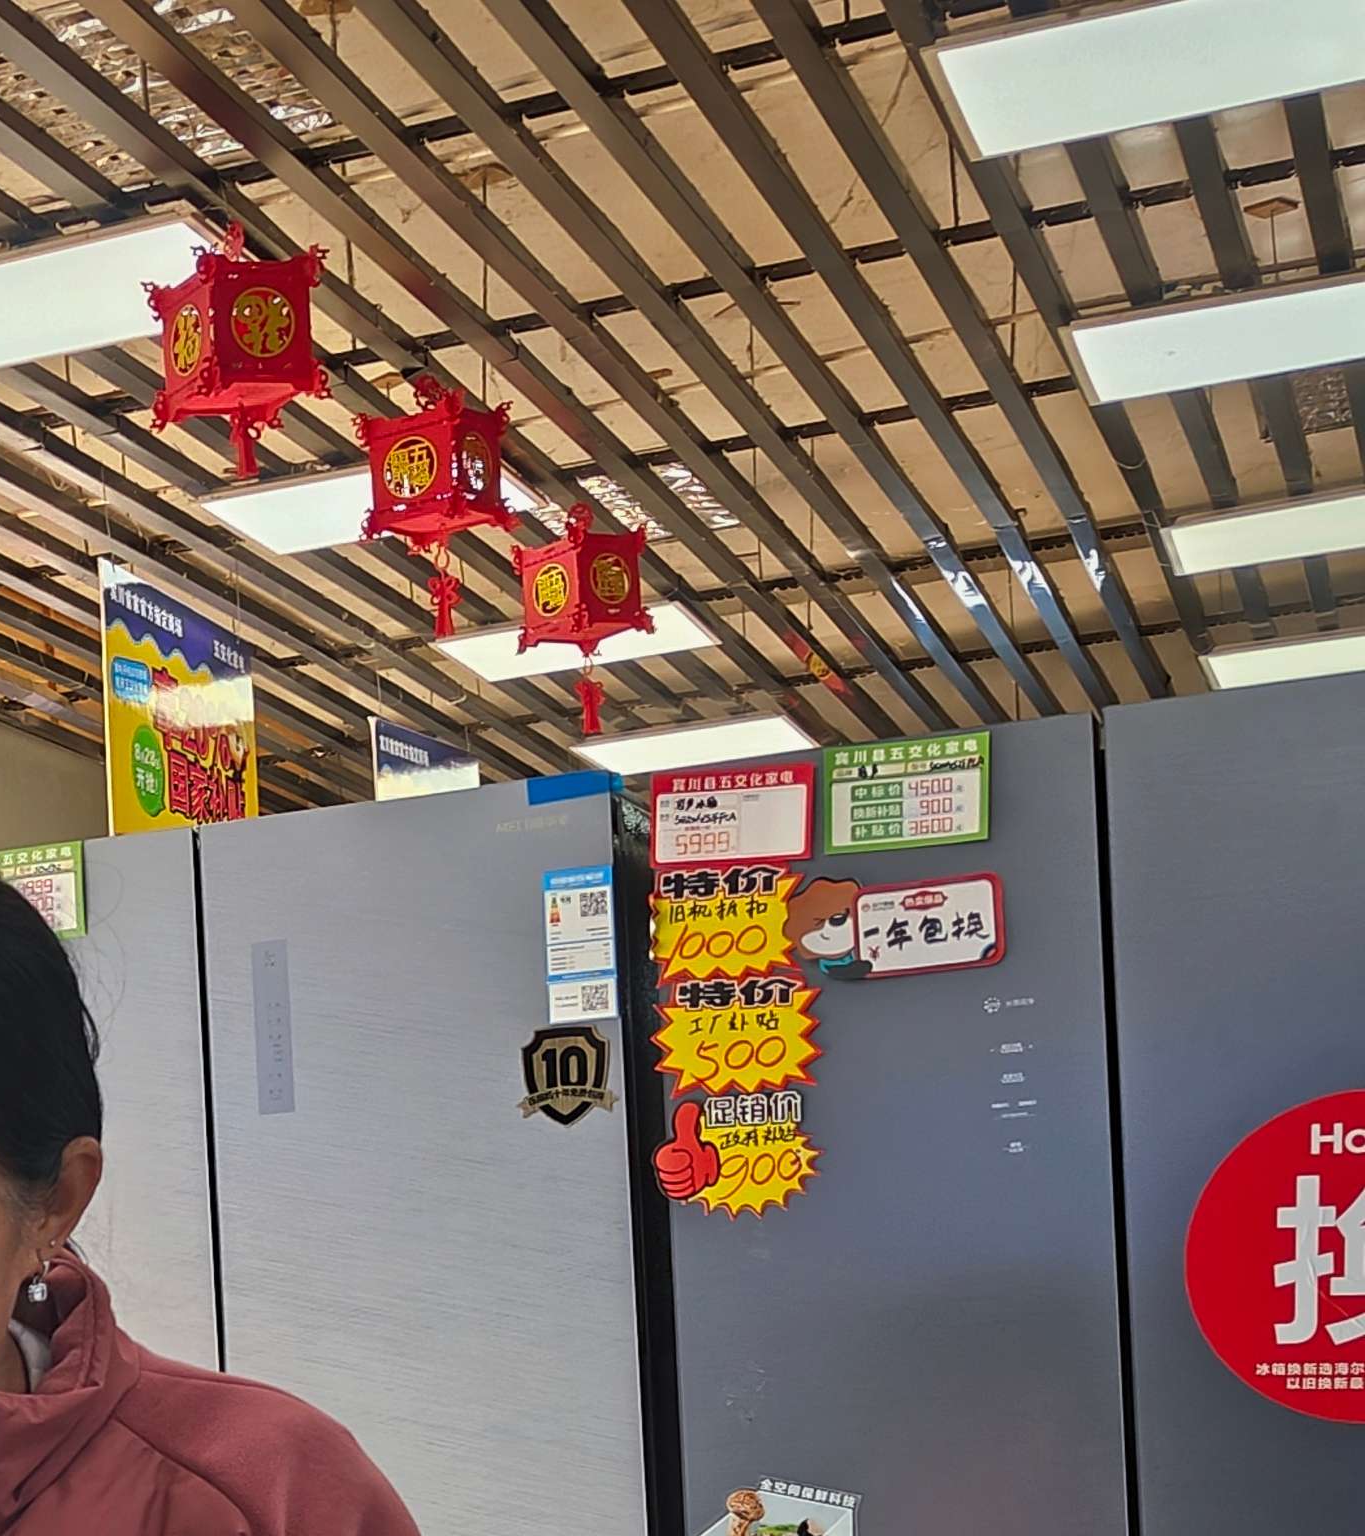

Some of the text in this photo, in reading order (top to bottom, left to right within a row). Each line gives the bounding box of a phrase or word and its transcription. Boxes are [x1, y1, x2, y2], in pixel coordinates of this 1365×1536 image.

[854, 777, 953, 799] 中标价 4500
[920, 797, 953, 816] 900
[854, 823, 901, 838] 补贴价
[663, 867, 778, 897] 特价
[670, 924, 768, 960] 1000
[864, 912, 990, 950] 一年包换
[679, 979, 796, 1007] 特价
[541, 1046, 588, 1088] 10
[692, 1036, 787, 1082] 500
[705, 1091, 802, 1126] 促销价
[719, 1149, 801, 1199] 900
